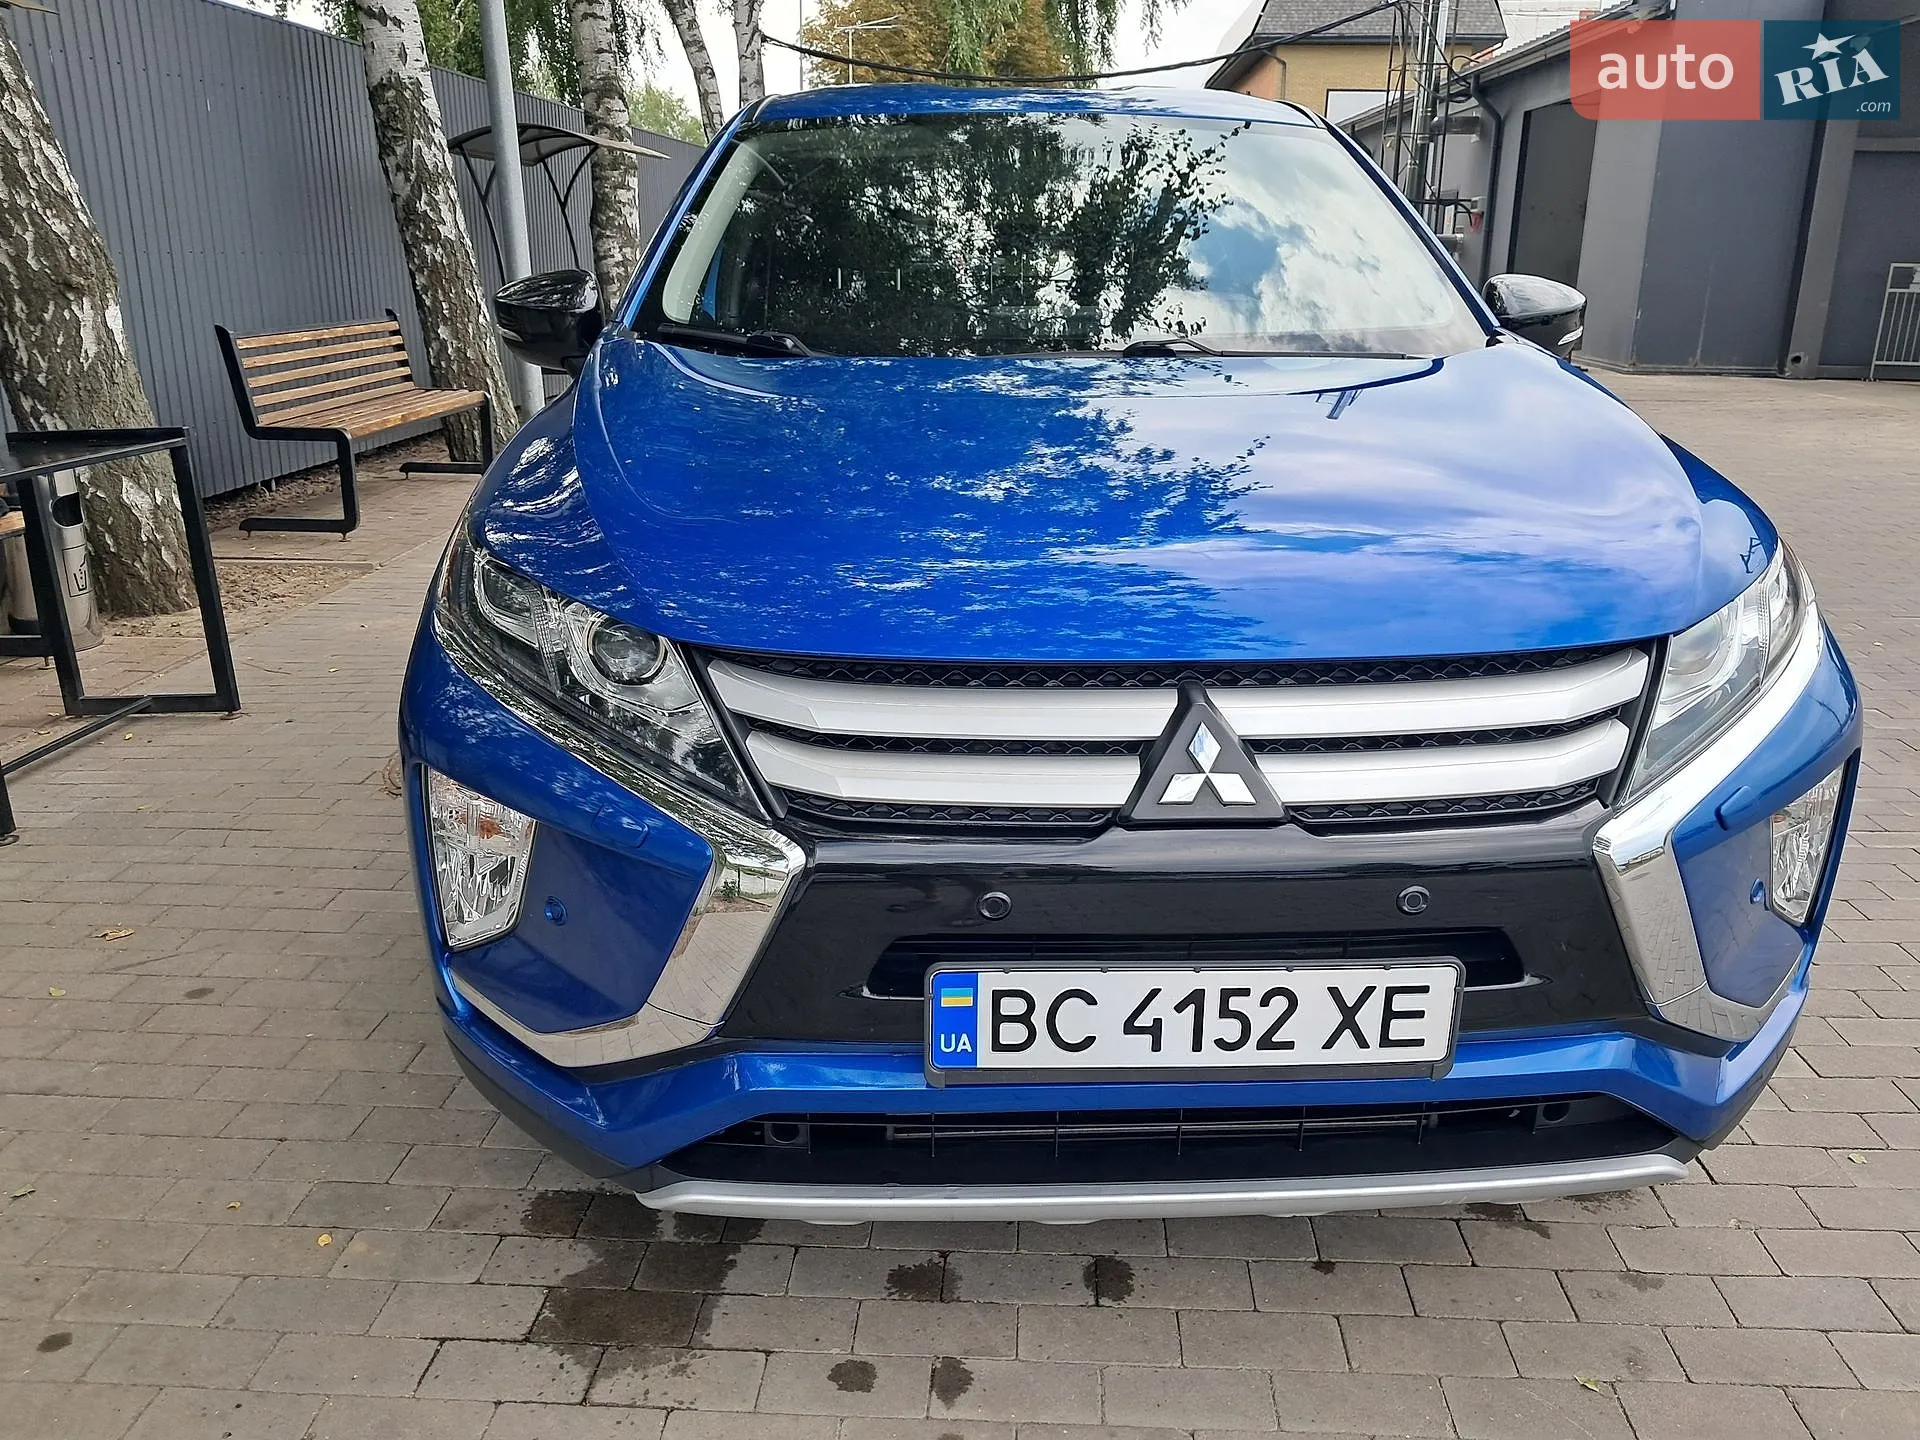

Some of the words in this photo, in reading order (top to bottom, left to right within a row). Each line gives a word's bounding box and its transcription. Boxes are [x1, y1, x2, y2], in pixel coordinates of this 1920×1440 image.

[990, 988, 1098, 1053] BC
[1122, 987, 1300, 1053] 4152
[1321, 985, 1431, 1050] XE
[940, 1034, 973, 1053] UA
